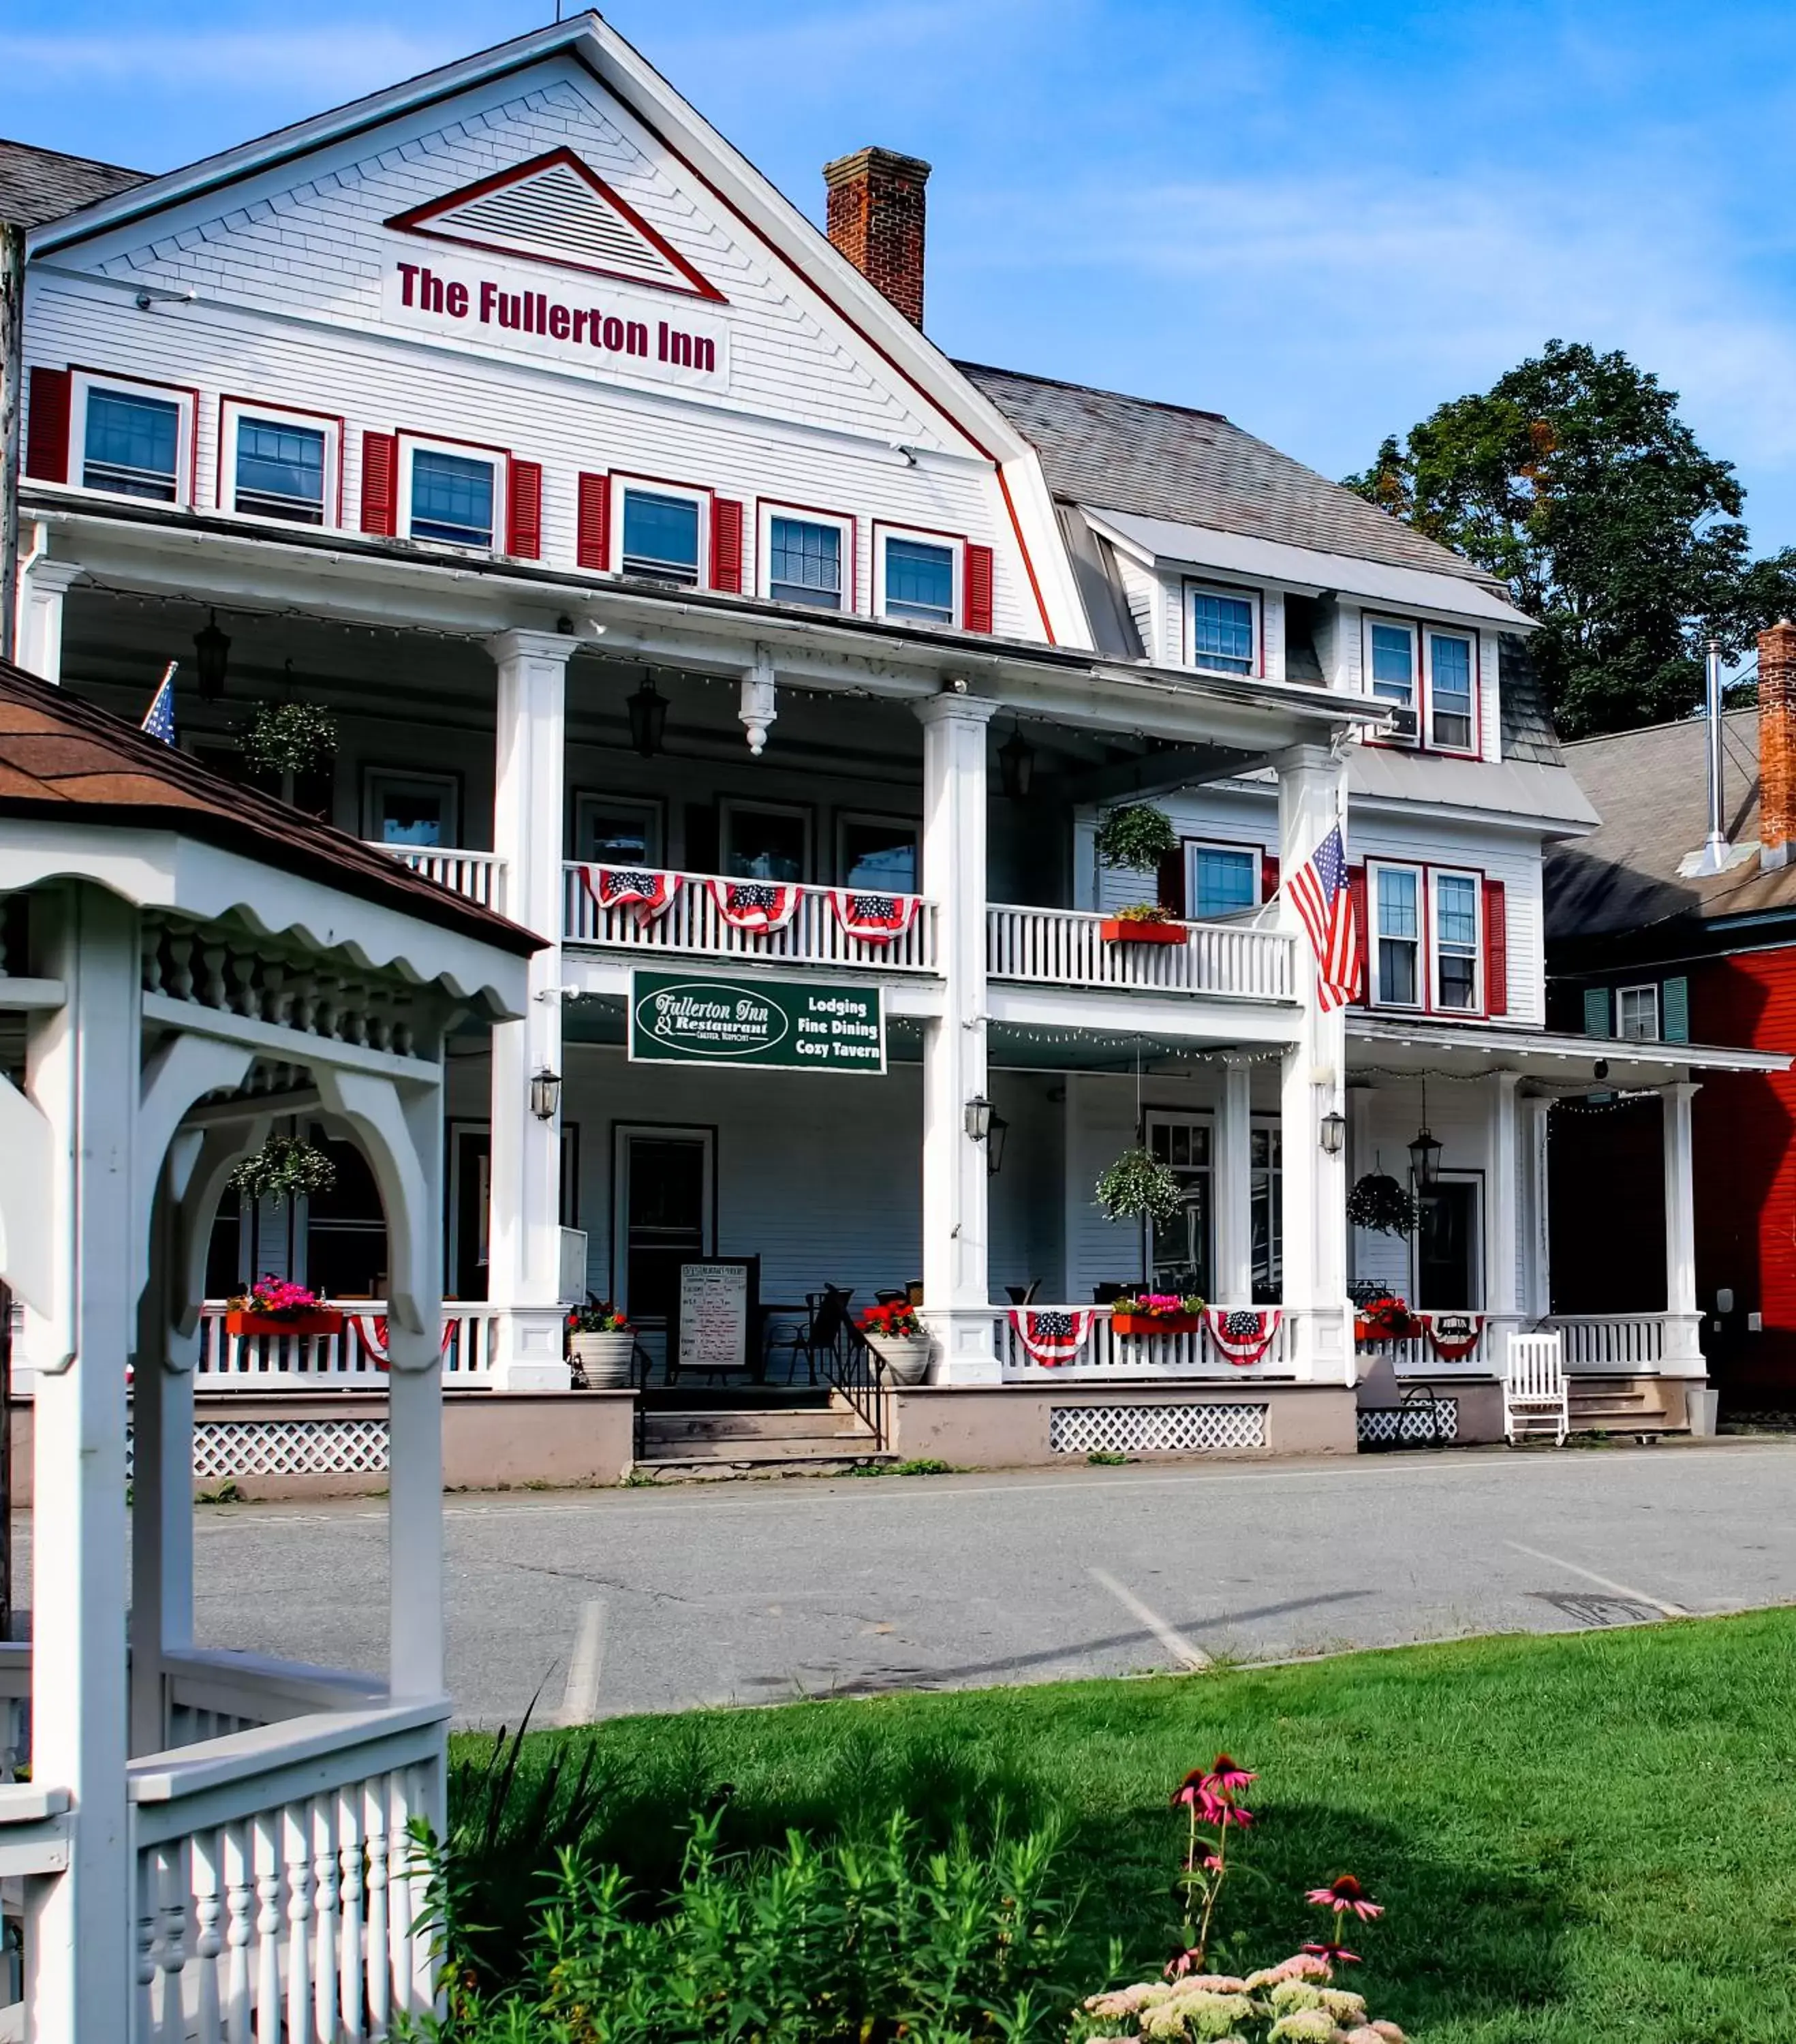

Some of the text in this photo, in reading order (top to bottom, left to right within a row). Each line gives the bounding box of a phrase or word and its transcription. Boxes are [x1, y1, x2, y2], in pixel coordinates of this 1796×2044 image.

[397, 262, 715, 373] The Fullerton Inn
[655, 993, 769, 1021] Fullerton Inn
[808, 997, 867, 1017] Lodging
[654, 1014, 768, 1036] & Restaurant
[798, 1017, 878, 1040] Fine Dining
[796, 1039, 880, 1058] Cozy Tavern
